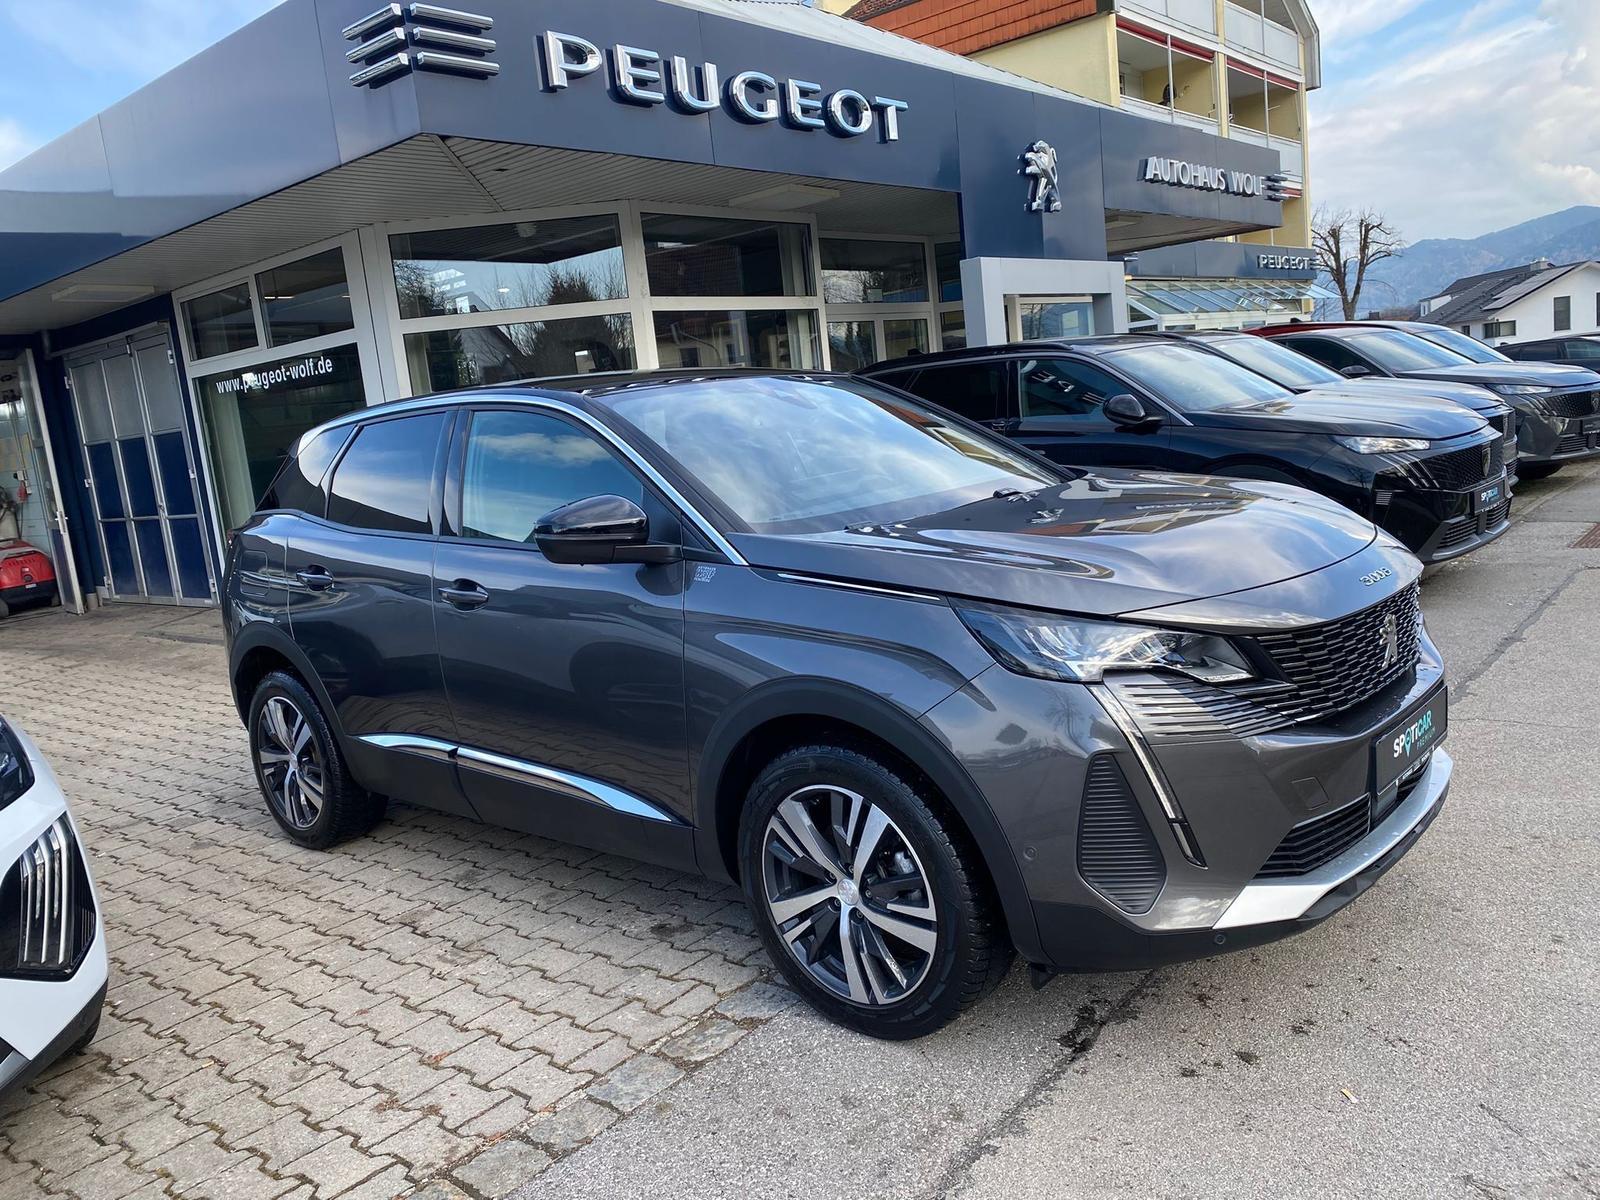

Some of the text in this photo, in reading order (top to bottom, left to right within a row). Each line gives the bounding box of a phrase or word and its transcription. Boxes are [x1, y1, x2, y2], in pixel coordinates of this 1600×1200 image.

[544, 29, 908, 144] PEUGEOT
[1144, 156, 1265, 196] AUTOHAUS WOLF
[1259, 254, 1310, 270] PEUGEOT
[1359, 566, 1392, 586] 3008
